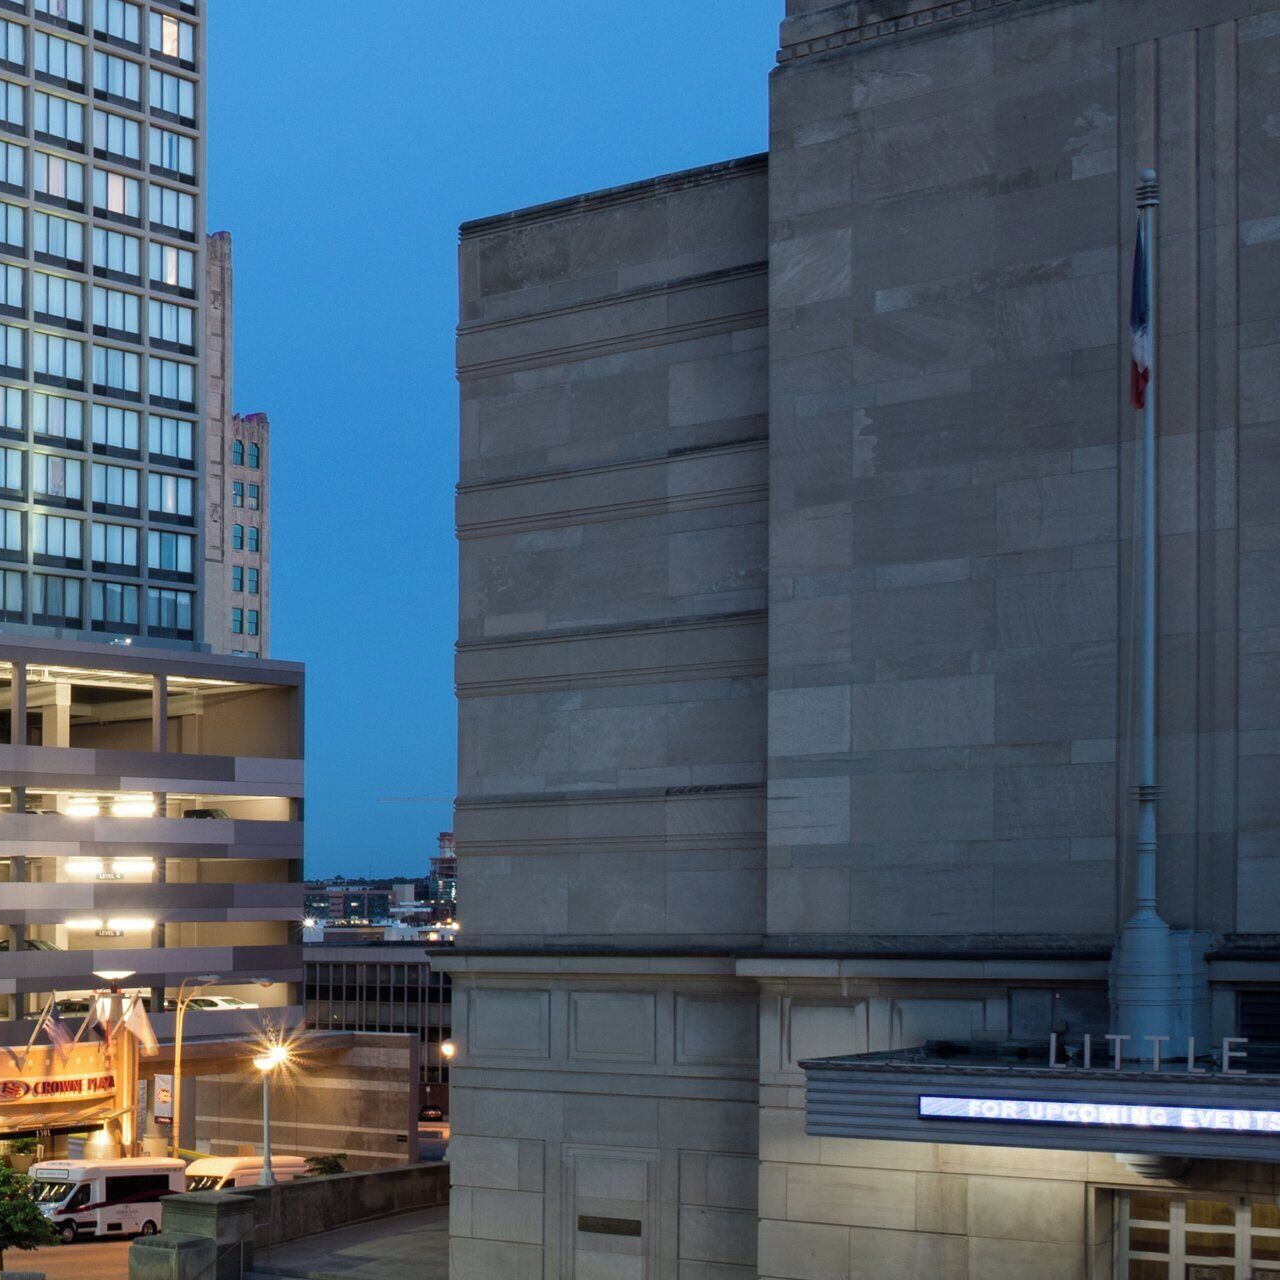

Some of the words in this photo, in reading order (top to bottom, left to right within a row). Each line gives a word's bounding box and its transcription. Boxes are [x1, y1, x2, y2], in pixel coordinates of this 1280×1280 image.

[1049, 1032, 1248, 1075] LITTLE
[968, 1099, 1020, 1118] FOR
[1028, 1102, 1169, 1127] UPCOMING
